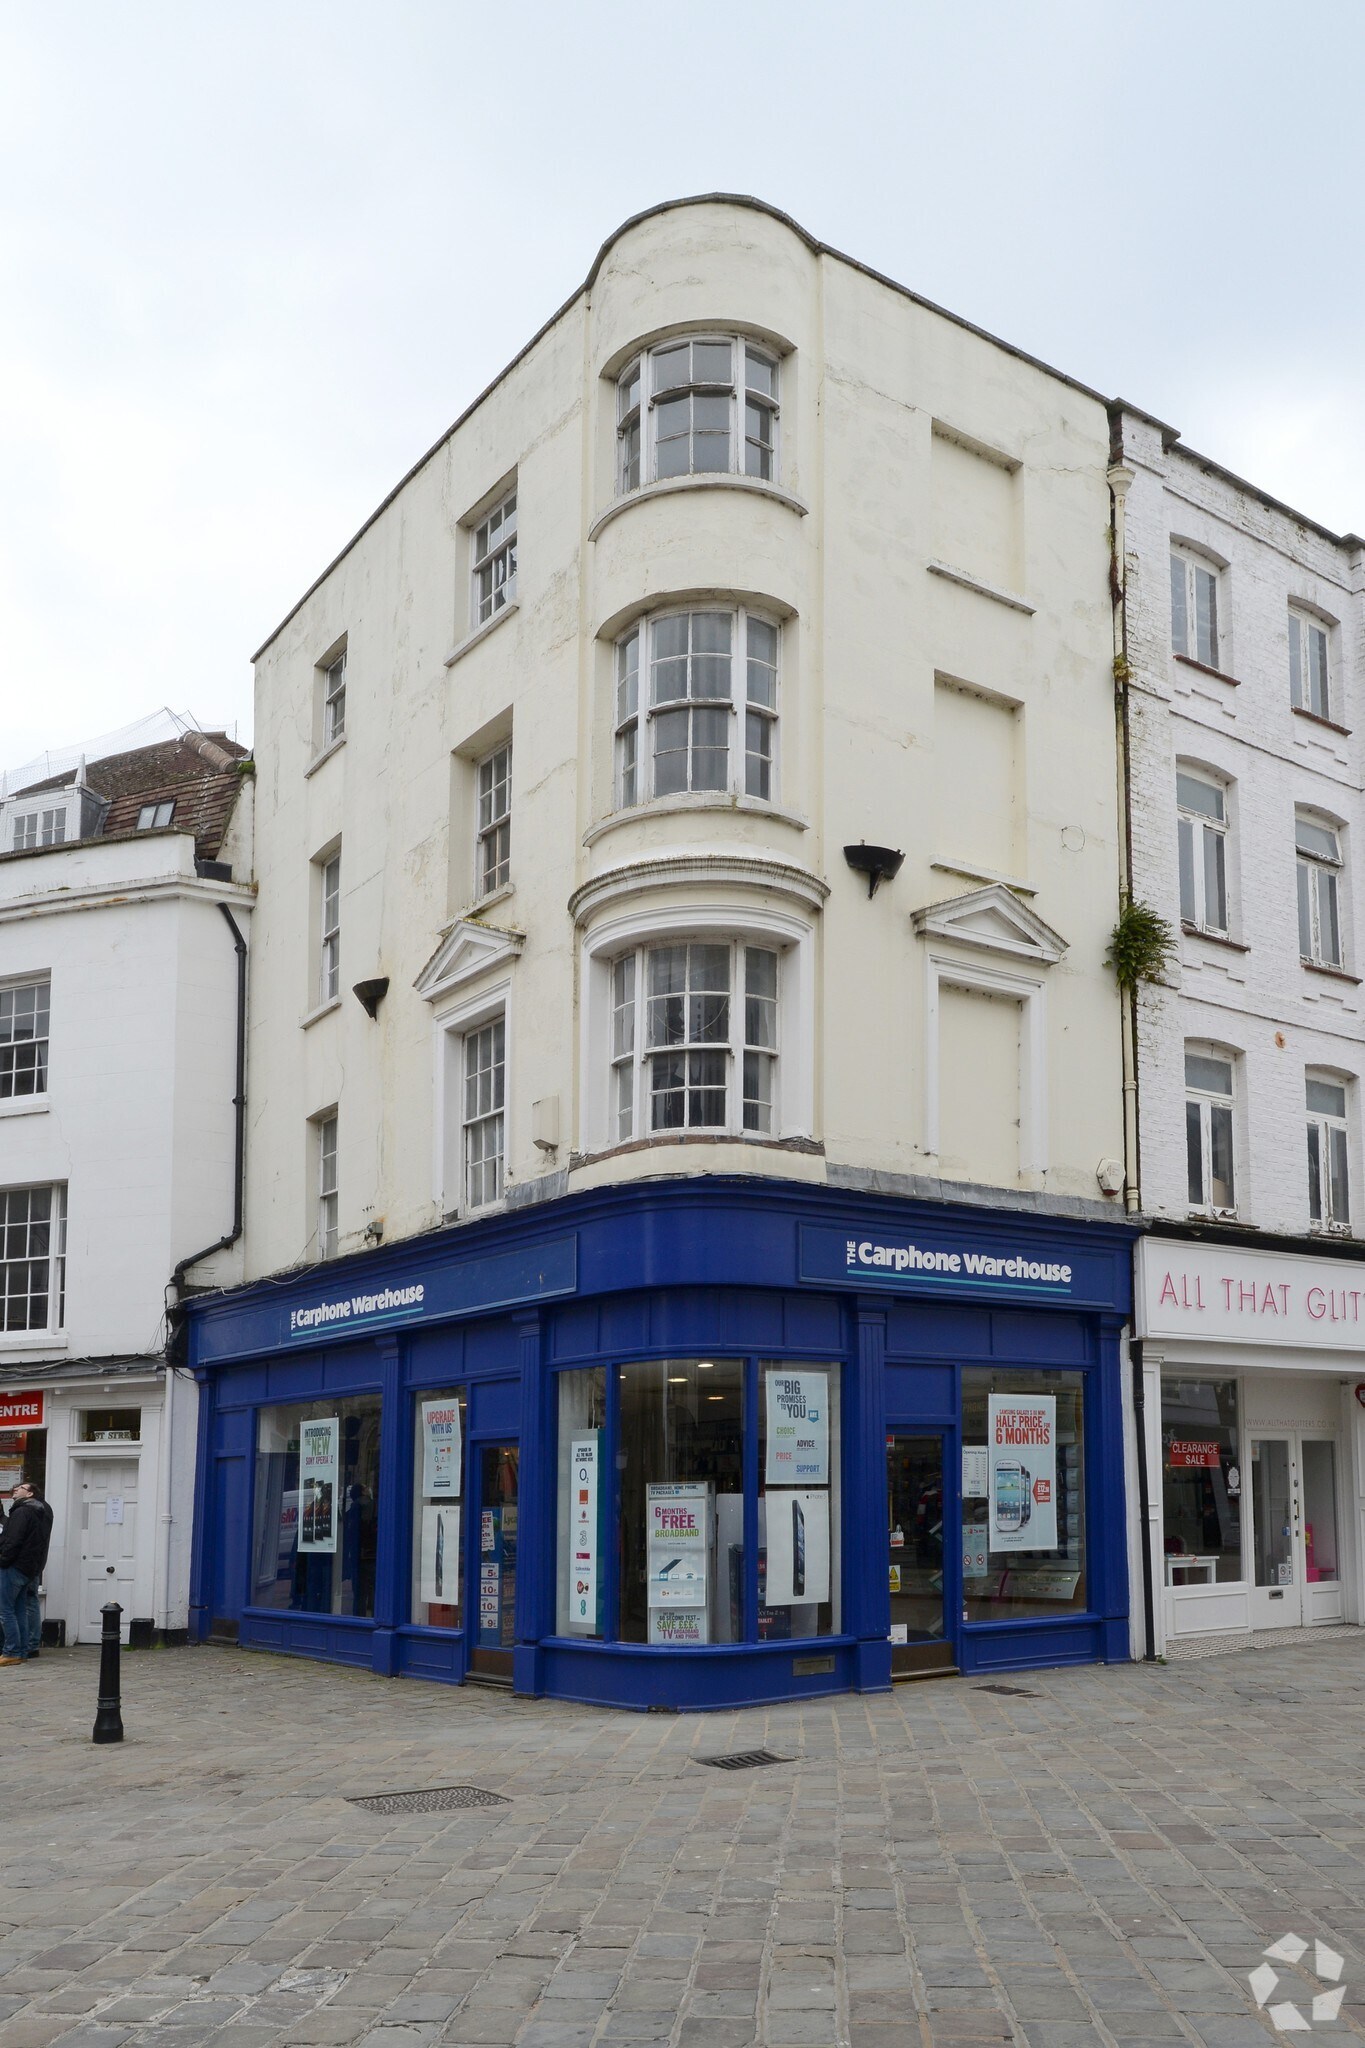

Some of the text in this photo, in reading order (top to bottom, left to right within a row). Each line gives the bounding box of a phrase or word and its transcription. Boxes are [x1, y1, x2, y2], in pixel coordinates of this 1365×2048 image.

[847, 1240, 1072, 1282] THE Carphone Warehouse
[1160, 1271, 1365, 1322] ALL THAT GLIT
[296, 1300, 351, 1327] Carphone
[351, 1284, 425, 1316] Warehouse
[775, 1379, 801, 1395] OUR BIG
[776, 1395, 807, 1404] PROMISES
[427, 1409, 455, 1425] UPGRADE
[787, 1404, 806, 1418] YOU
[996, 1415, 1016, 1428] HALF
[1019, 1415, 1043, 1428] PRICE
[304, 1426, 332, 1439] INTRODUCING
[431, 1423, 453, 1434] WITH US
[776, 1427, 796, 1435] CHOICE
[995, 1428, 1050, 1445] 6 MONTHS
[311, 1436, 331, 1457] NEW
[796, 1440, 815, 1448] ADVICE
[1172, 1443, 1218, 1455] CLEARANCE
[305, 1456, 315, 1466] SONY
[775, 1452, 792, 1460] PRICE
[1185, 1454, 1205, 1465] SALE
[796, 1464, 820, 1473] SUPPORT
[655, 1506, 688, 1518] 6 MONTHS
[662, 1514, 696, 1529] FREE
[655, 1529, 700, 1538] BROADBAND
[656, 1621, 676, 1630] SAVE
[663, 1629, 673, 1640] TV
